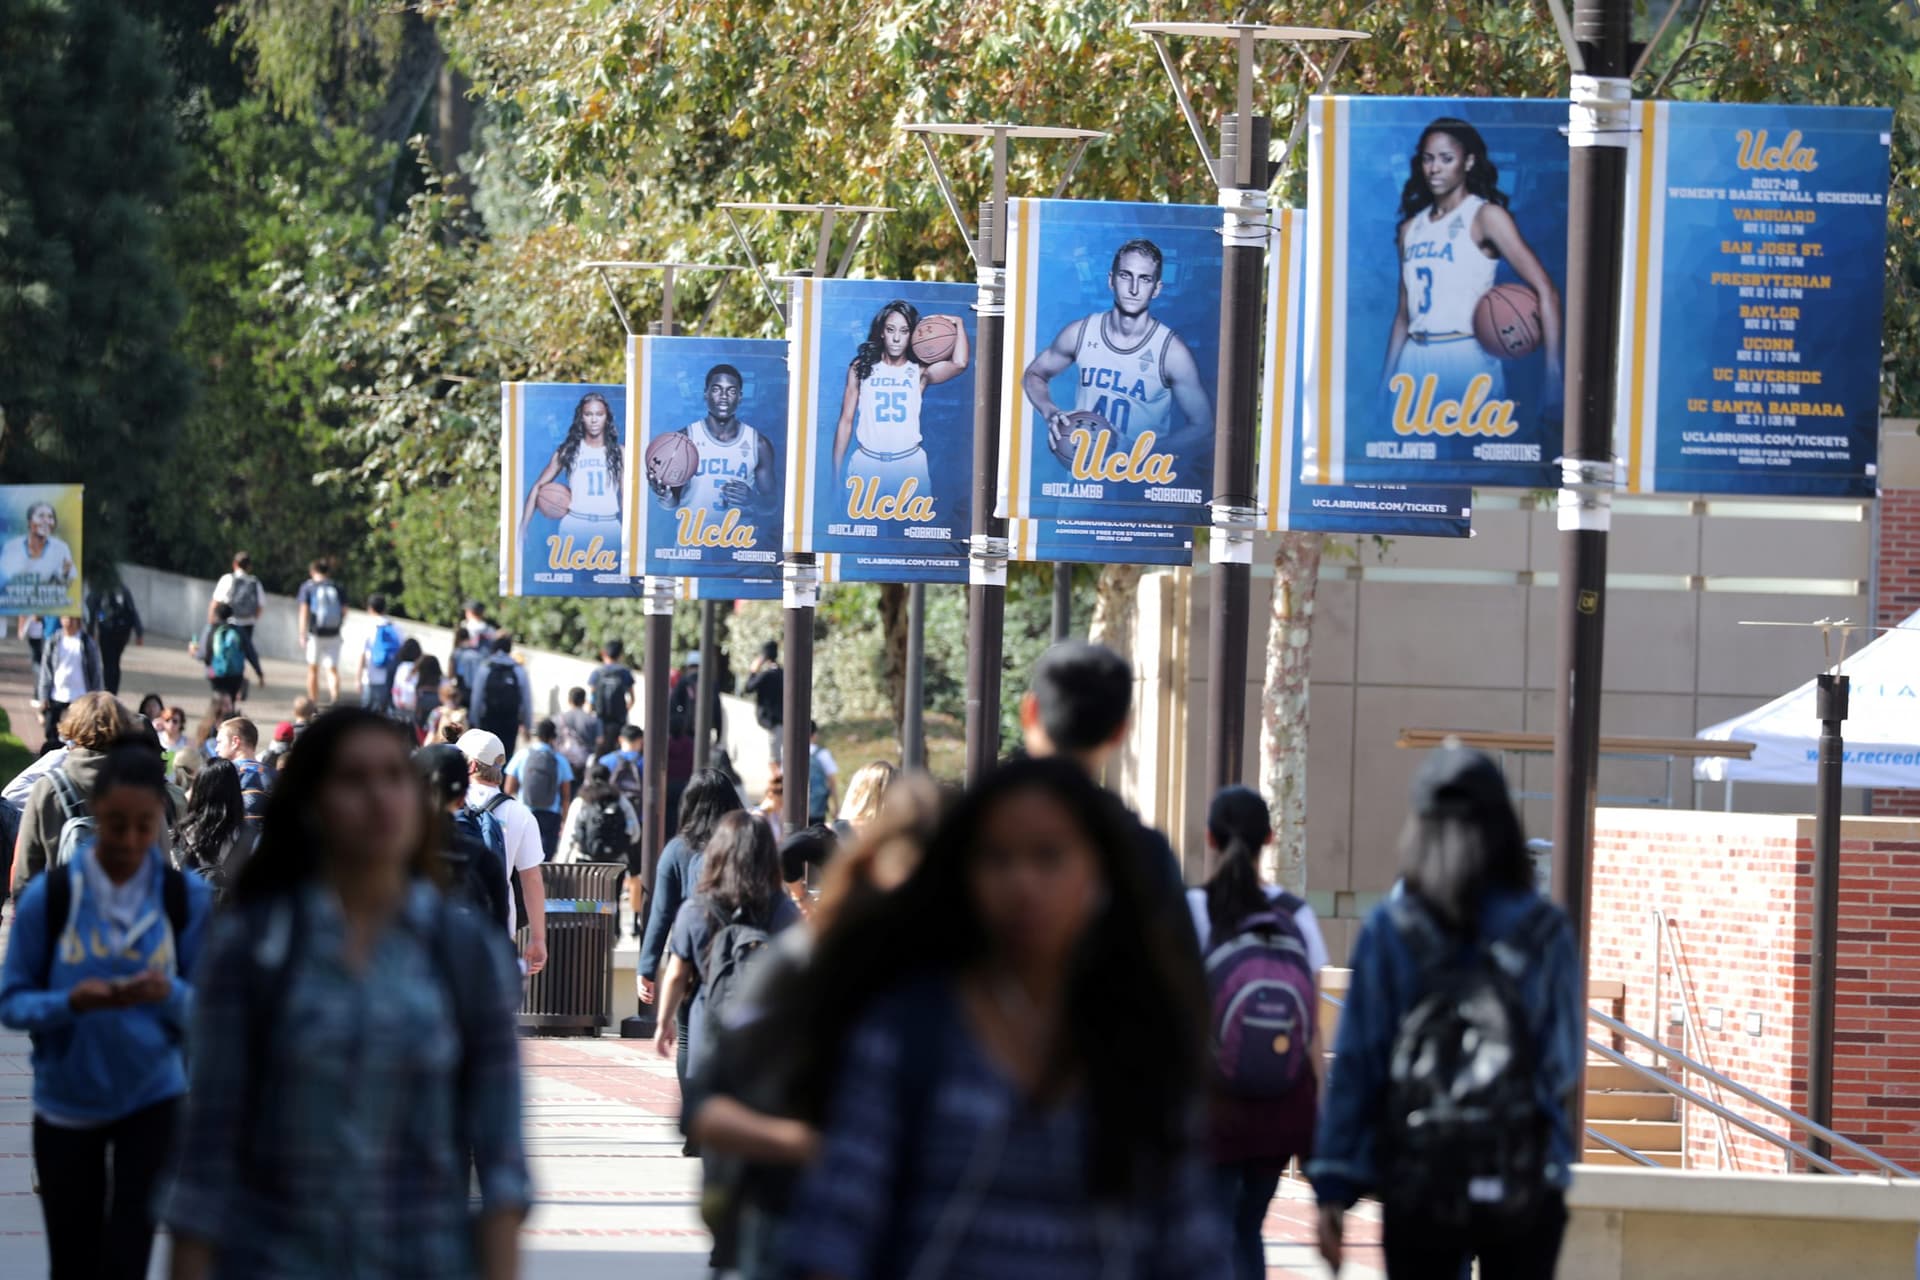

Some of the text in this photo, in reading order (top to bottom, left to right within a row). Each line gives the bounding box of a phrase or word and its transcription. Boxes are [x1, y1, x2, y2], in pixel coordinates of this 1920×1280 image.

[1736, 129, 1818, 172] Ucla
[1668, 187, 1883, 205] WOMEN'S BASKETBALL SCHEDULE
[1733, 208, 1816, 223] VANGUARD
[1403, 240, 1454, 262] UCLA
[1720, 240, 1825, 256] SAN JOSE ST.
[1711, 272, 1831, 289] PRESBYTERIAN
[1415, 266, 1434, 315] 3
[1739, 305, 1800, 320] BAYLOR
[1743, 337, 1794, 351] UCONN
[870, 377, 913, 388] UCLA
[1081, 367, 1147, 402] UCLA
[1713, 368, 1822, 384] UC RIVERSIDE
[875, 391, 907, 423] 25
[1390, 373, 1519, 438] Ucla
[1687, 399, 1845, 417] UC SANTA BARBARA
[1682, 432, 1849, 448] UCLABRUINS.COM/TICKETS
[1069, 428, 1178, 485] Ucla
[1365, 442, 1542, 462] @UCLAWBB #GOBRUINS
[1781, 450, 1826, 460] STUDENTS
[1826, 452, 1850, 461] WITH
[696, 458, 748, 480] UCLA
[1767, 458, 1792, 467] CARD
[586, 471, 605, 496] 11
[846, 475, 937, 522] Ucla
[1042, 483, 1202, 504] @UCLAMBB #GOBRUINS
[1312, 499, 1448, 513] UCLABRUINS.COM/TICKETS
[675, 506, 758, 548] Ucla
[546, 534, 619, 572] Ucla
[857, 557, 960, 568] UCLABRUINS.COM/TICKETS
